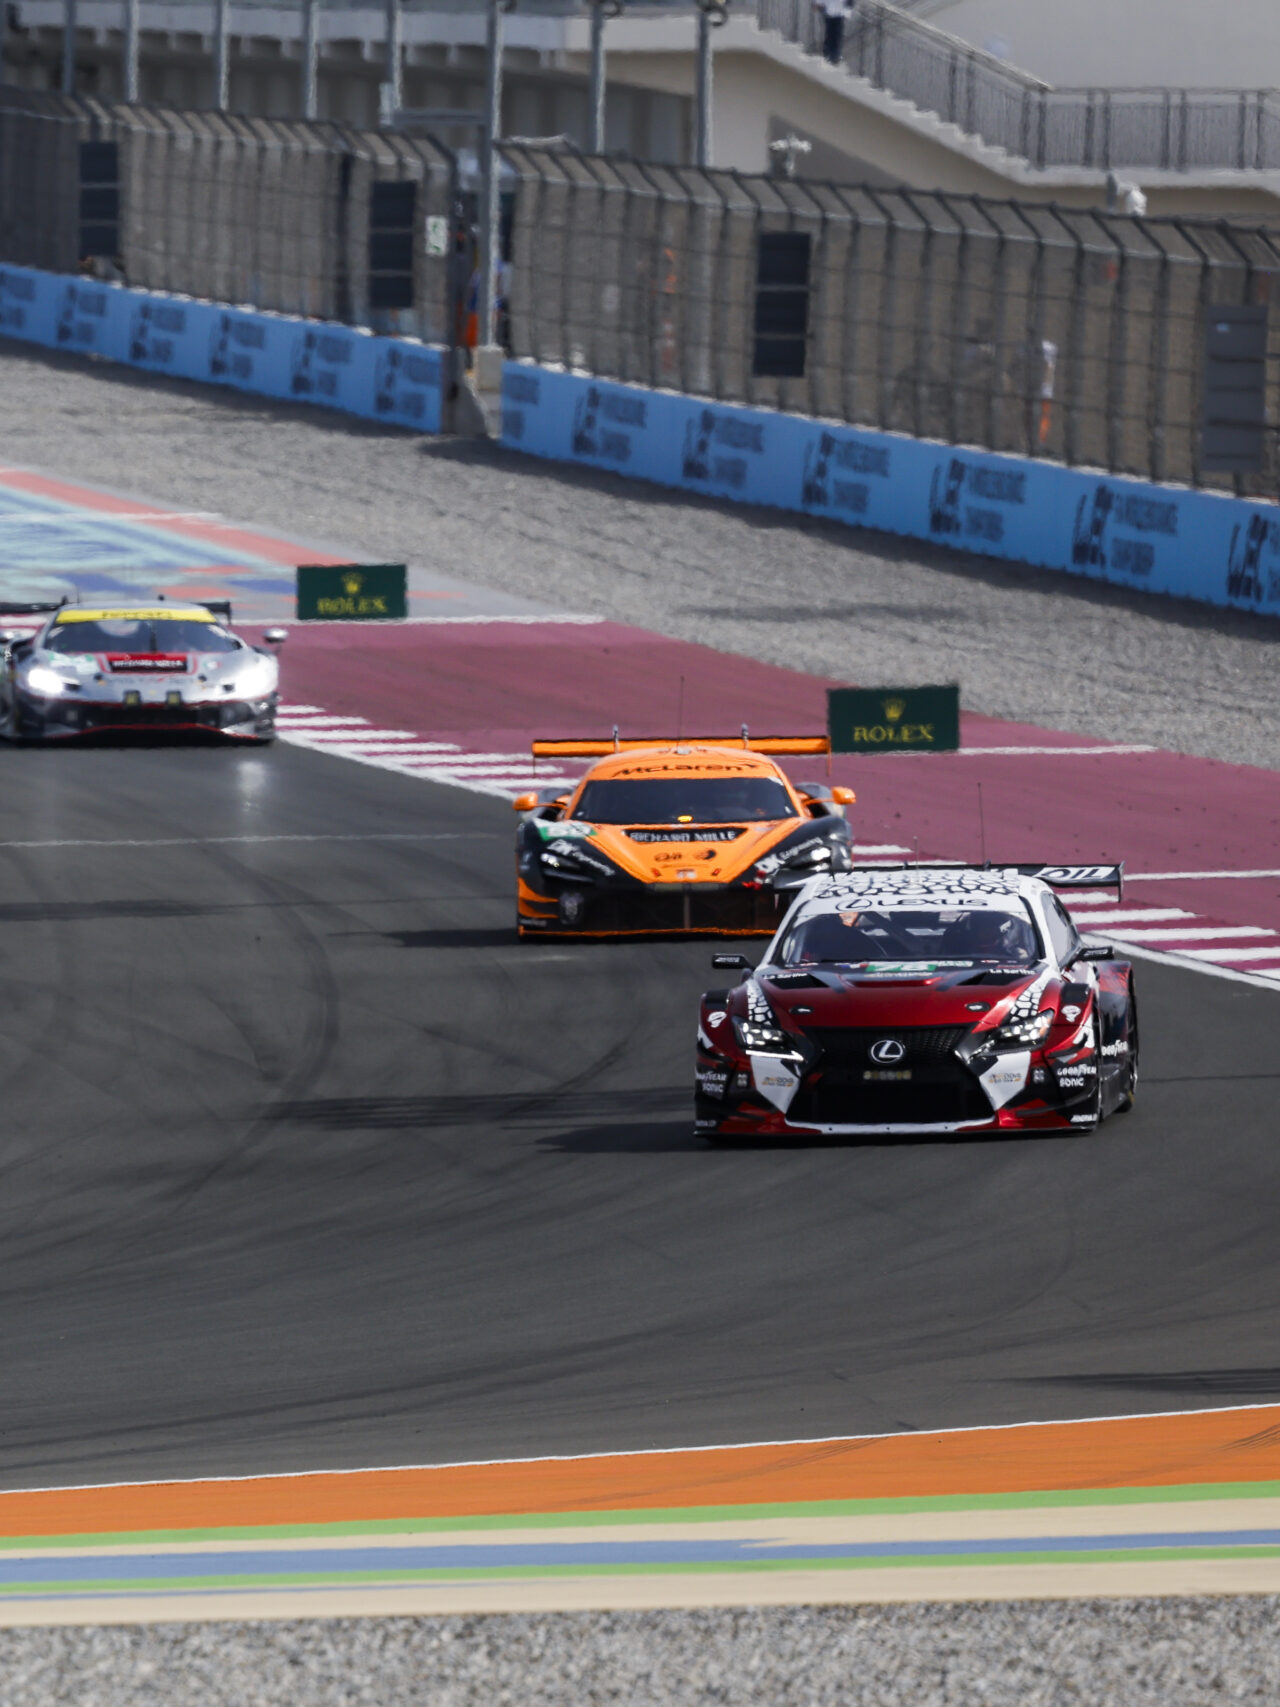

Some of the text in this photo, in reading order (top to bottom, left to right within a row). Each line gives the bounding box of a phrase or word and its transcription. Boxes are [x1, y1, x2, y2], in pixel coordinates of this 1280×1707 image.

[317, 597, 388, 614] ROLEX
[853, 724, 934, 742] ROLEX
[877, 898, 988, 907] LEXUS
